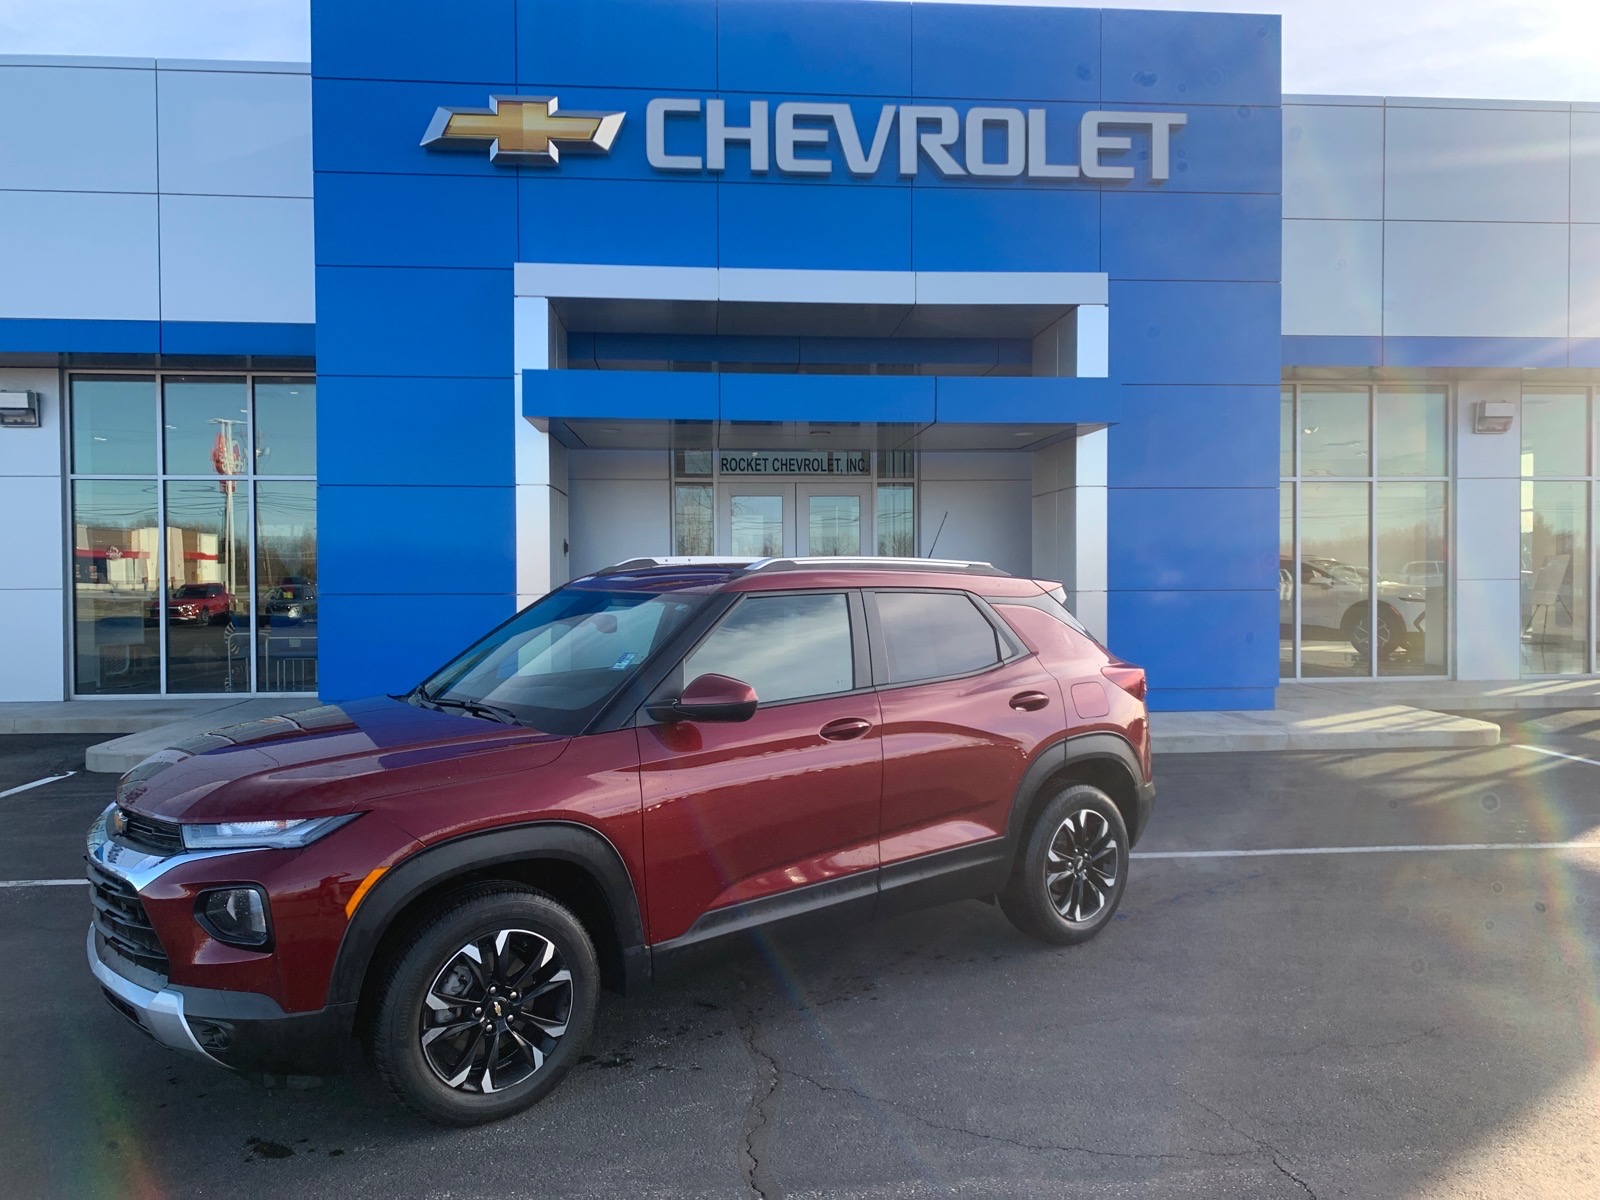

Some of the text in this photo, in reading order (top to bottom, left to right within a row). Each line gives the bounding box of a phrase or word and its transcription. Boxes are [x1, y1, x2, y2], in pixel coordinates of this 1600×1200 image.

[645, 97, 1188, 183] CHEVROLET
[720, 456, 869, 475] ROCKET CHEVROLET, INC.
